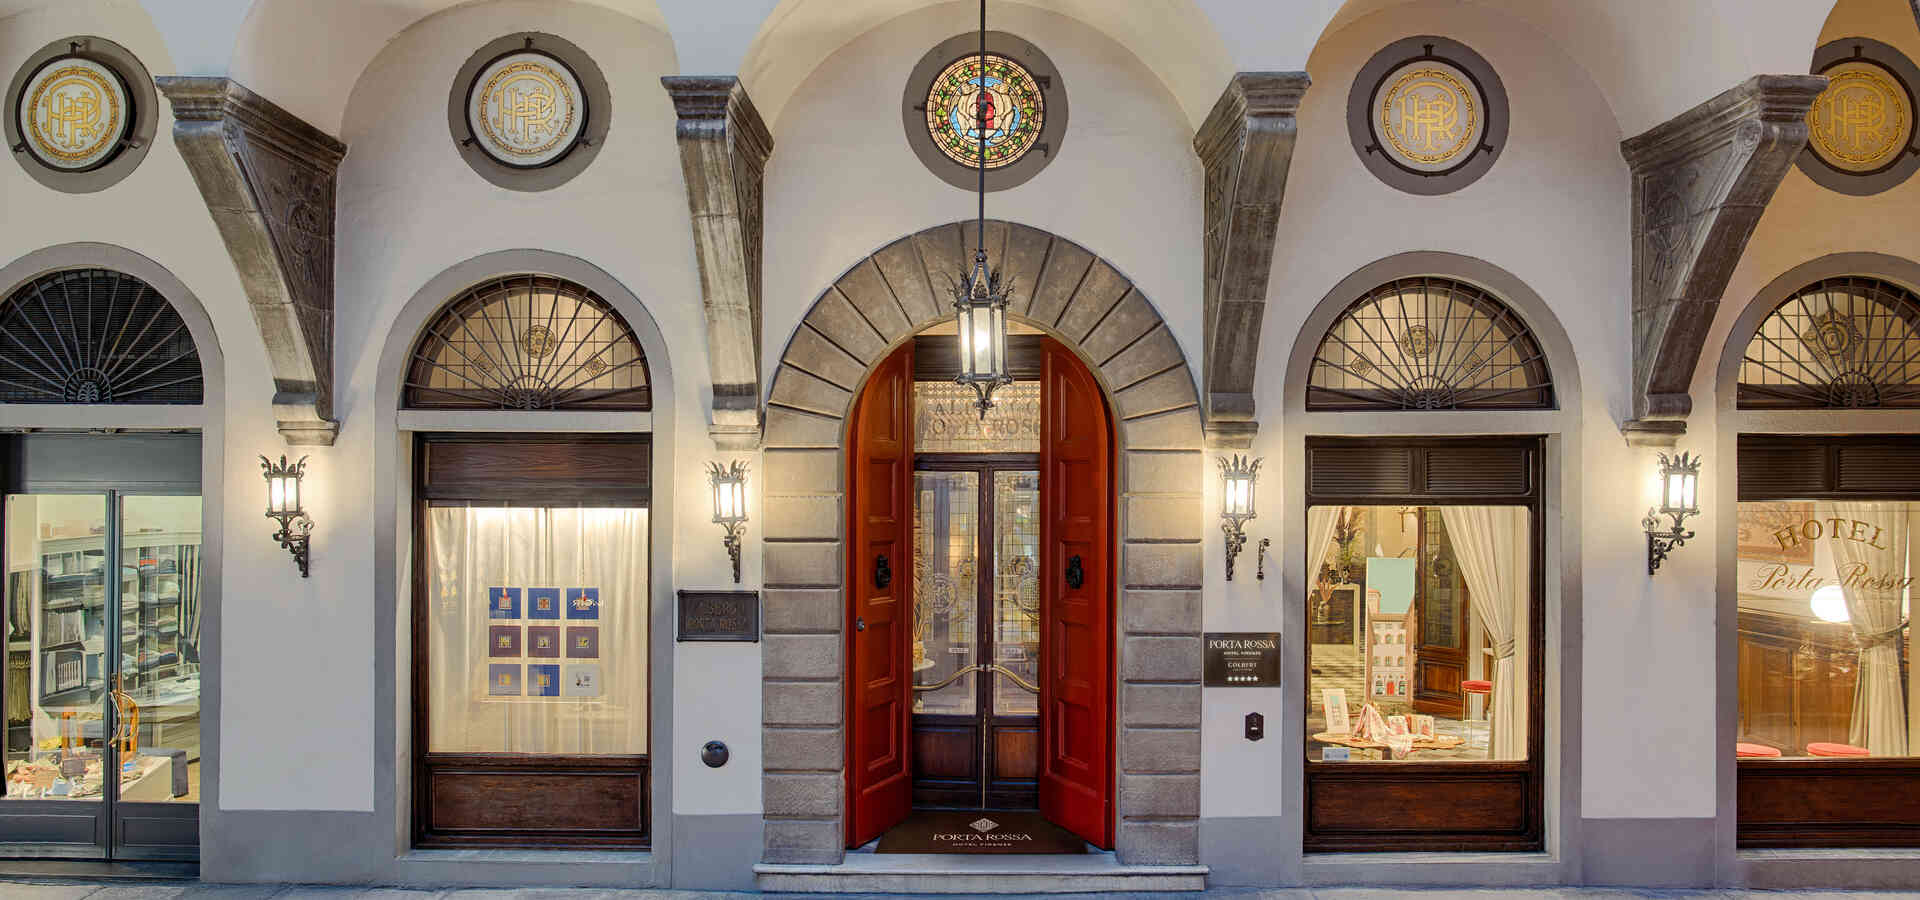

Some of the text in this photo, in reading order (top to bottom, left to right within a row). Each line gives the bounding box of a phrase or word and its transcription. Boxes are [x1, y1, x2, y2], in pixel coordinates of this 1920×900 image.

[1773, 518, 1888, 551] HOTEL
[1752, 561, 1915, 592] Porta Rossa
[1209, 639, 1276, 649] PORTA ROSSA
[932, 833, 1033, 841] PORTA ROSSA
